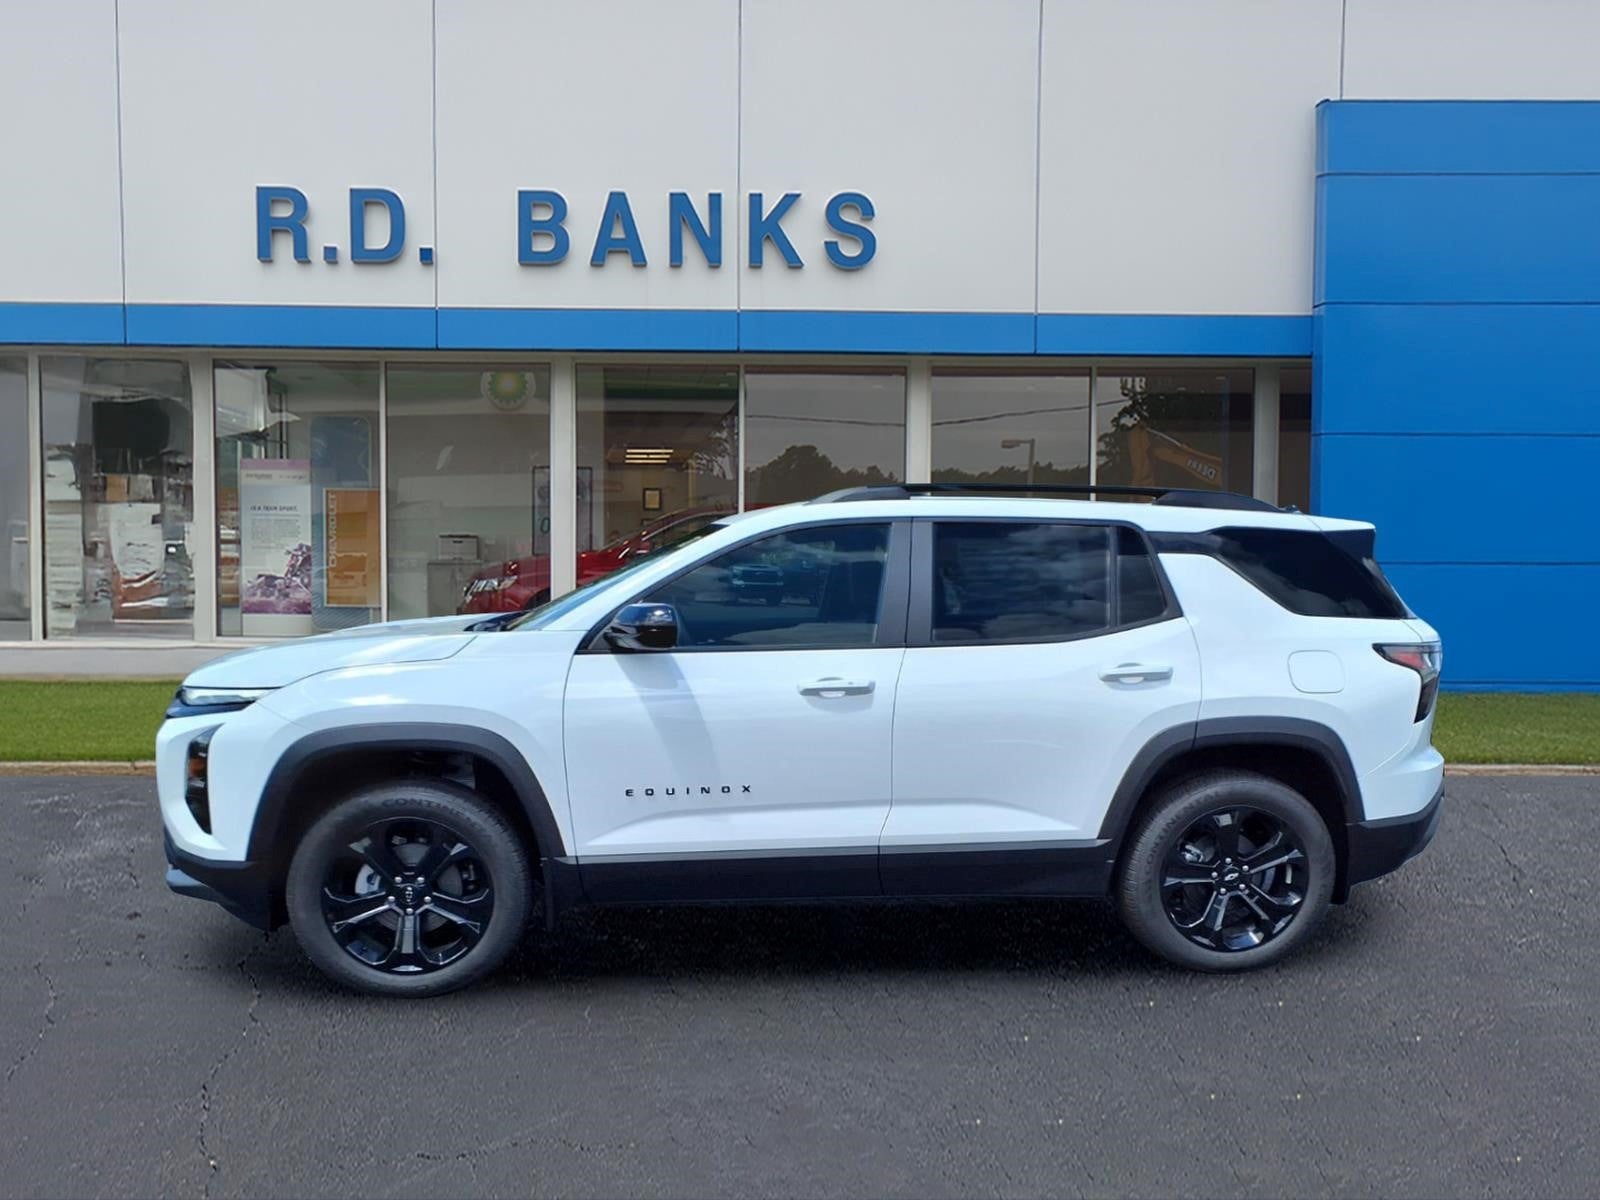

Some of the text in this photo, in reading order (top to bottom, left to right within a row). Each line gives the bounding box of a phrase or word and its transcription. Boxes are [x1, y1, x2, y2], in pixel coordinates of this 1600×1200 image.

[256, 186, 877, 270] R.D. BANKS
[328, 491, 337, 568] CHEVROLET
[625, 785, 751, 797] EQUINOX
